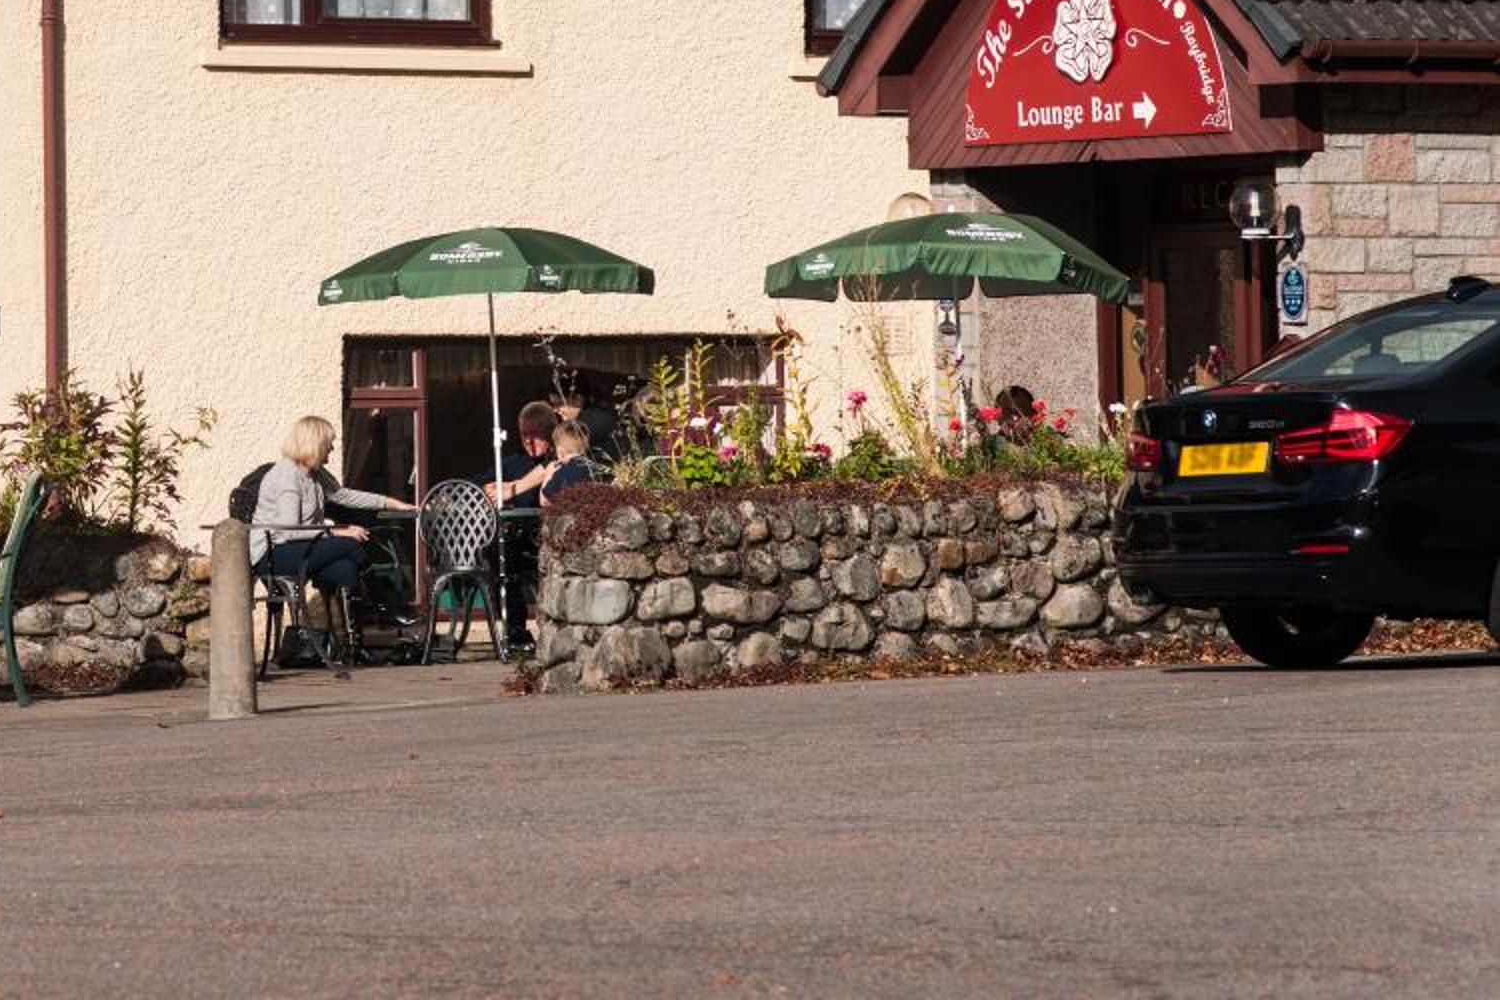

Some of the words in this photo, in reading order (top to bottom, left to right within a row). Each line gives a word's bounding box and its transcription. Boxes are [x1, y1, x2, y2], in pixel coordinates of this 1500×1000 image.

[977, 19, 1013, 89] The
[1017, 101, 1084, 131] Lounge
[1091, 96, 1124, 123] Bar
